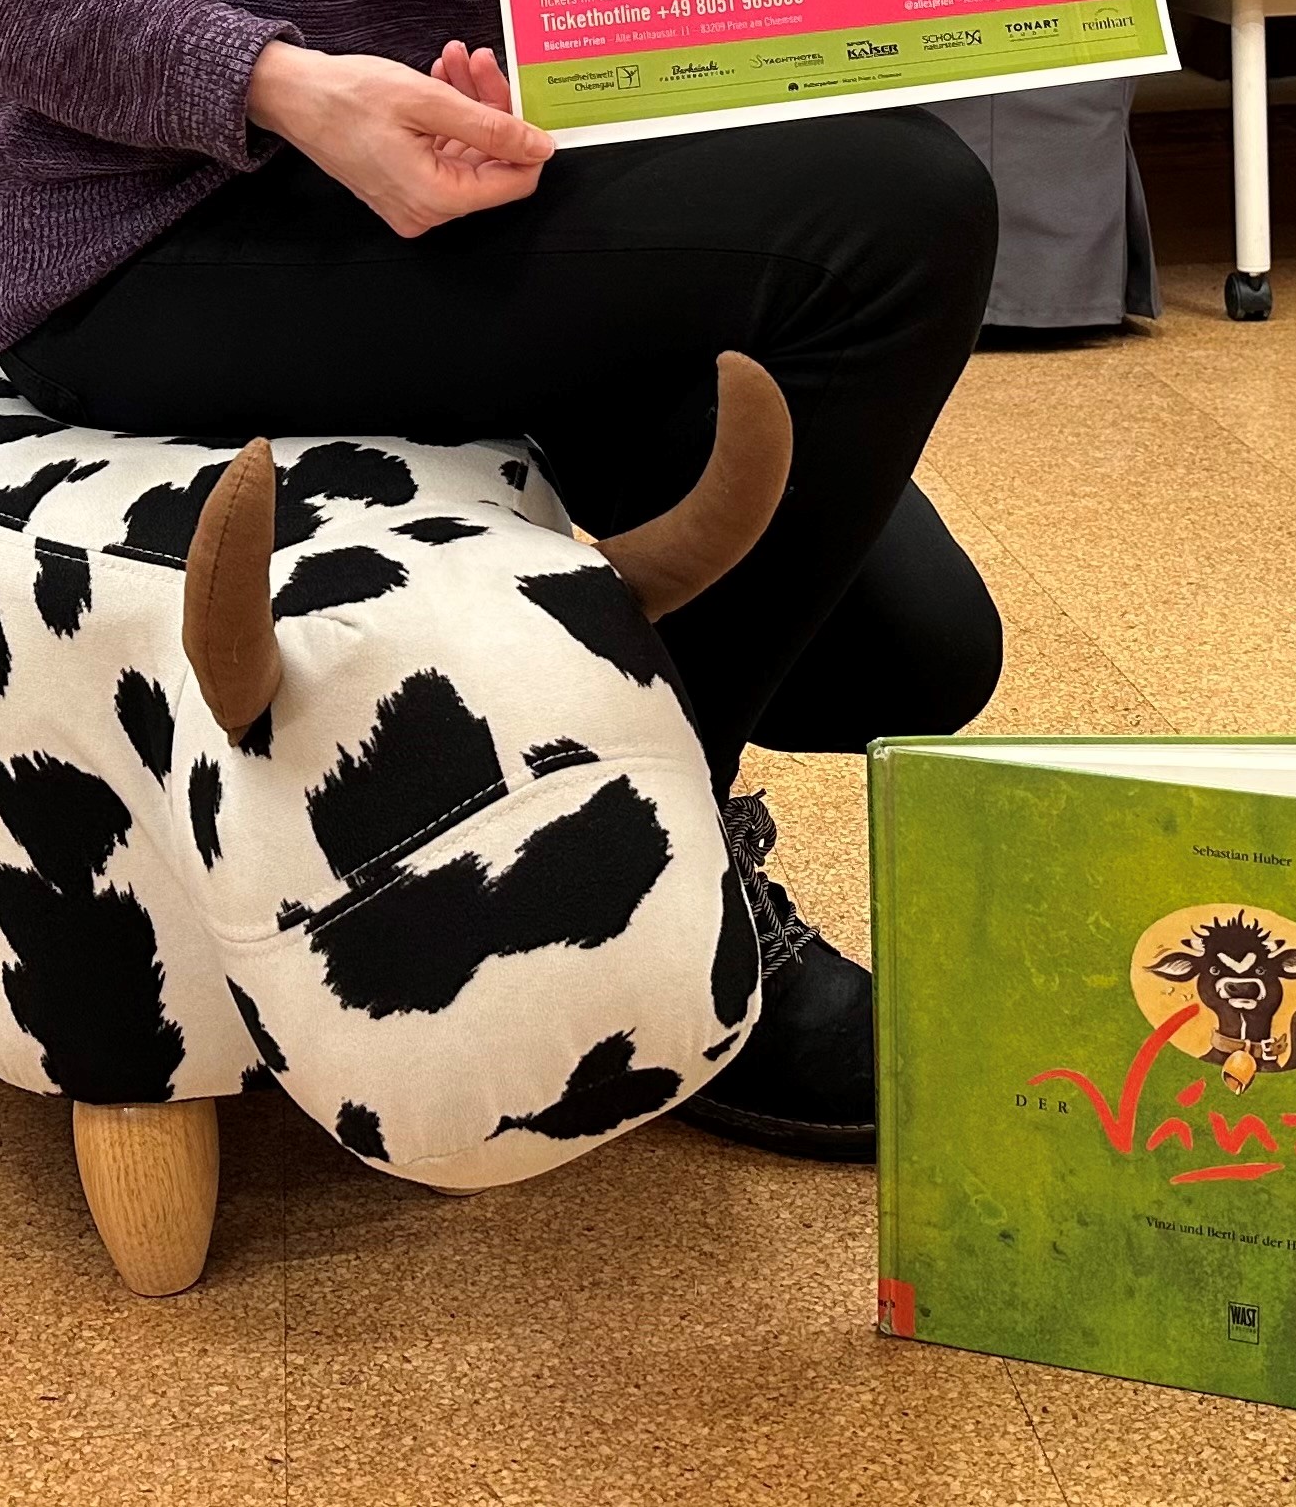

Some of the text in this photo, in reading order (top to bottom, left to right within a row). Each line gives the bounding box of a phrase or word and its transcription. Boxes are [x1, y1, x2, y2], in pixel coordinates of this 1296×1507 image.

[540, 4, 651, 32] Tickethotline
[1005, 18, 1059, 33] TONART
[1082, 15, 1135, 32] reinhart
[544, 38, 581, 51] Bücherei
[583, 36, 606, 47] Prien
[922, 31, 964, 44] SCHOLZ
[1192, 844, 1293, 867] Sebastian Huber
[1015, 1094, 1070, 1114] DER
[1145, 1215, 1176, 1232] Vinzi
[1180, 1223, 1204, 1236] und
[1207, 1226, 1236, 1243] Bertl
[1239, 1233, 1259, 1245] auf
[1262, 1235, 1283, 1249] der
[1230, 1305, 1257, 1327] WAST
